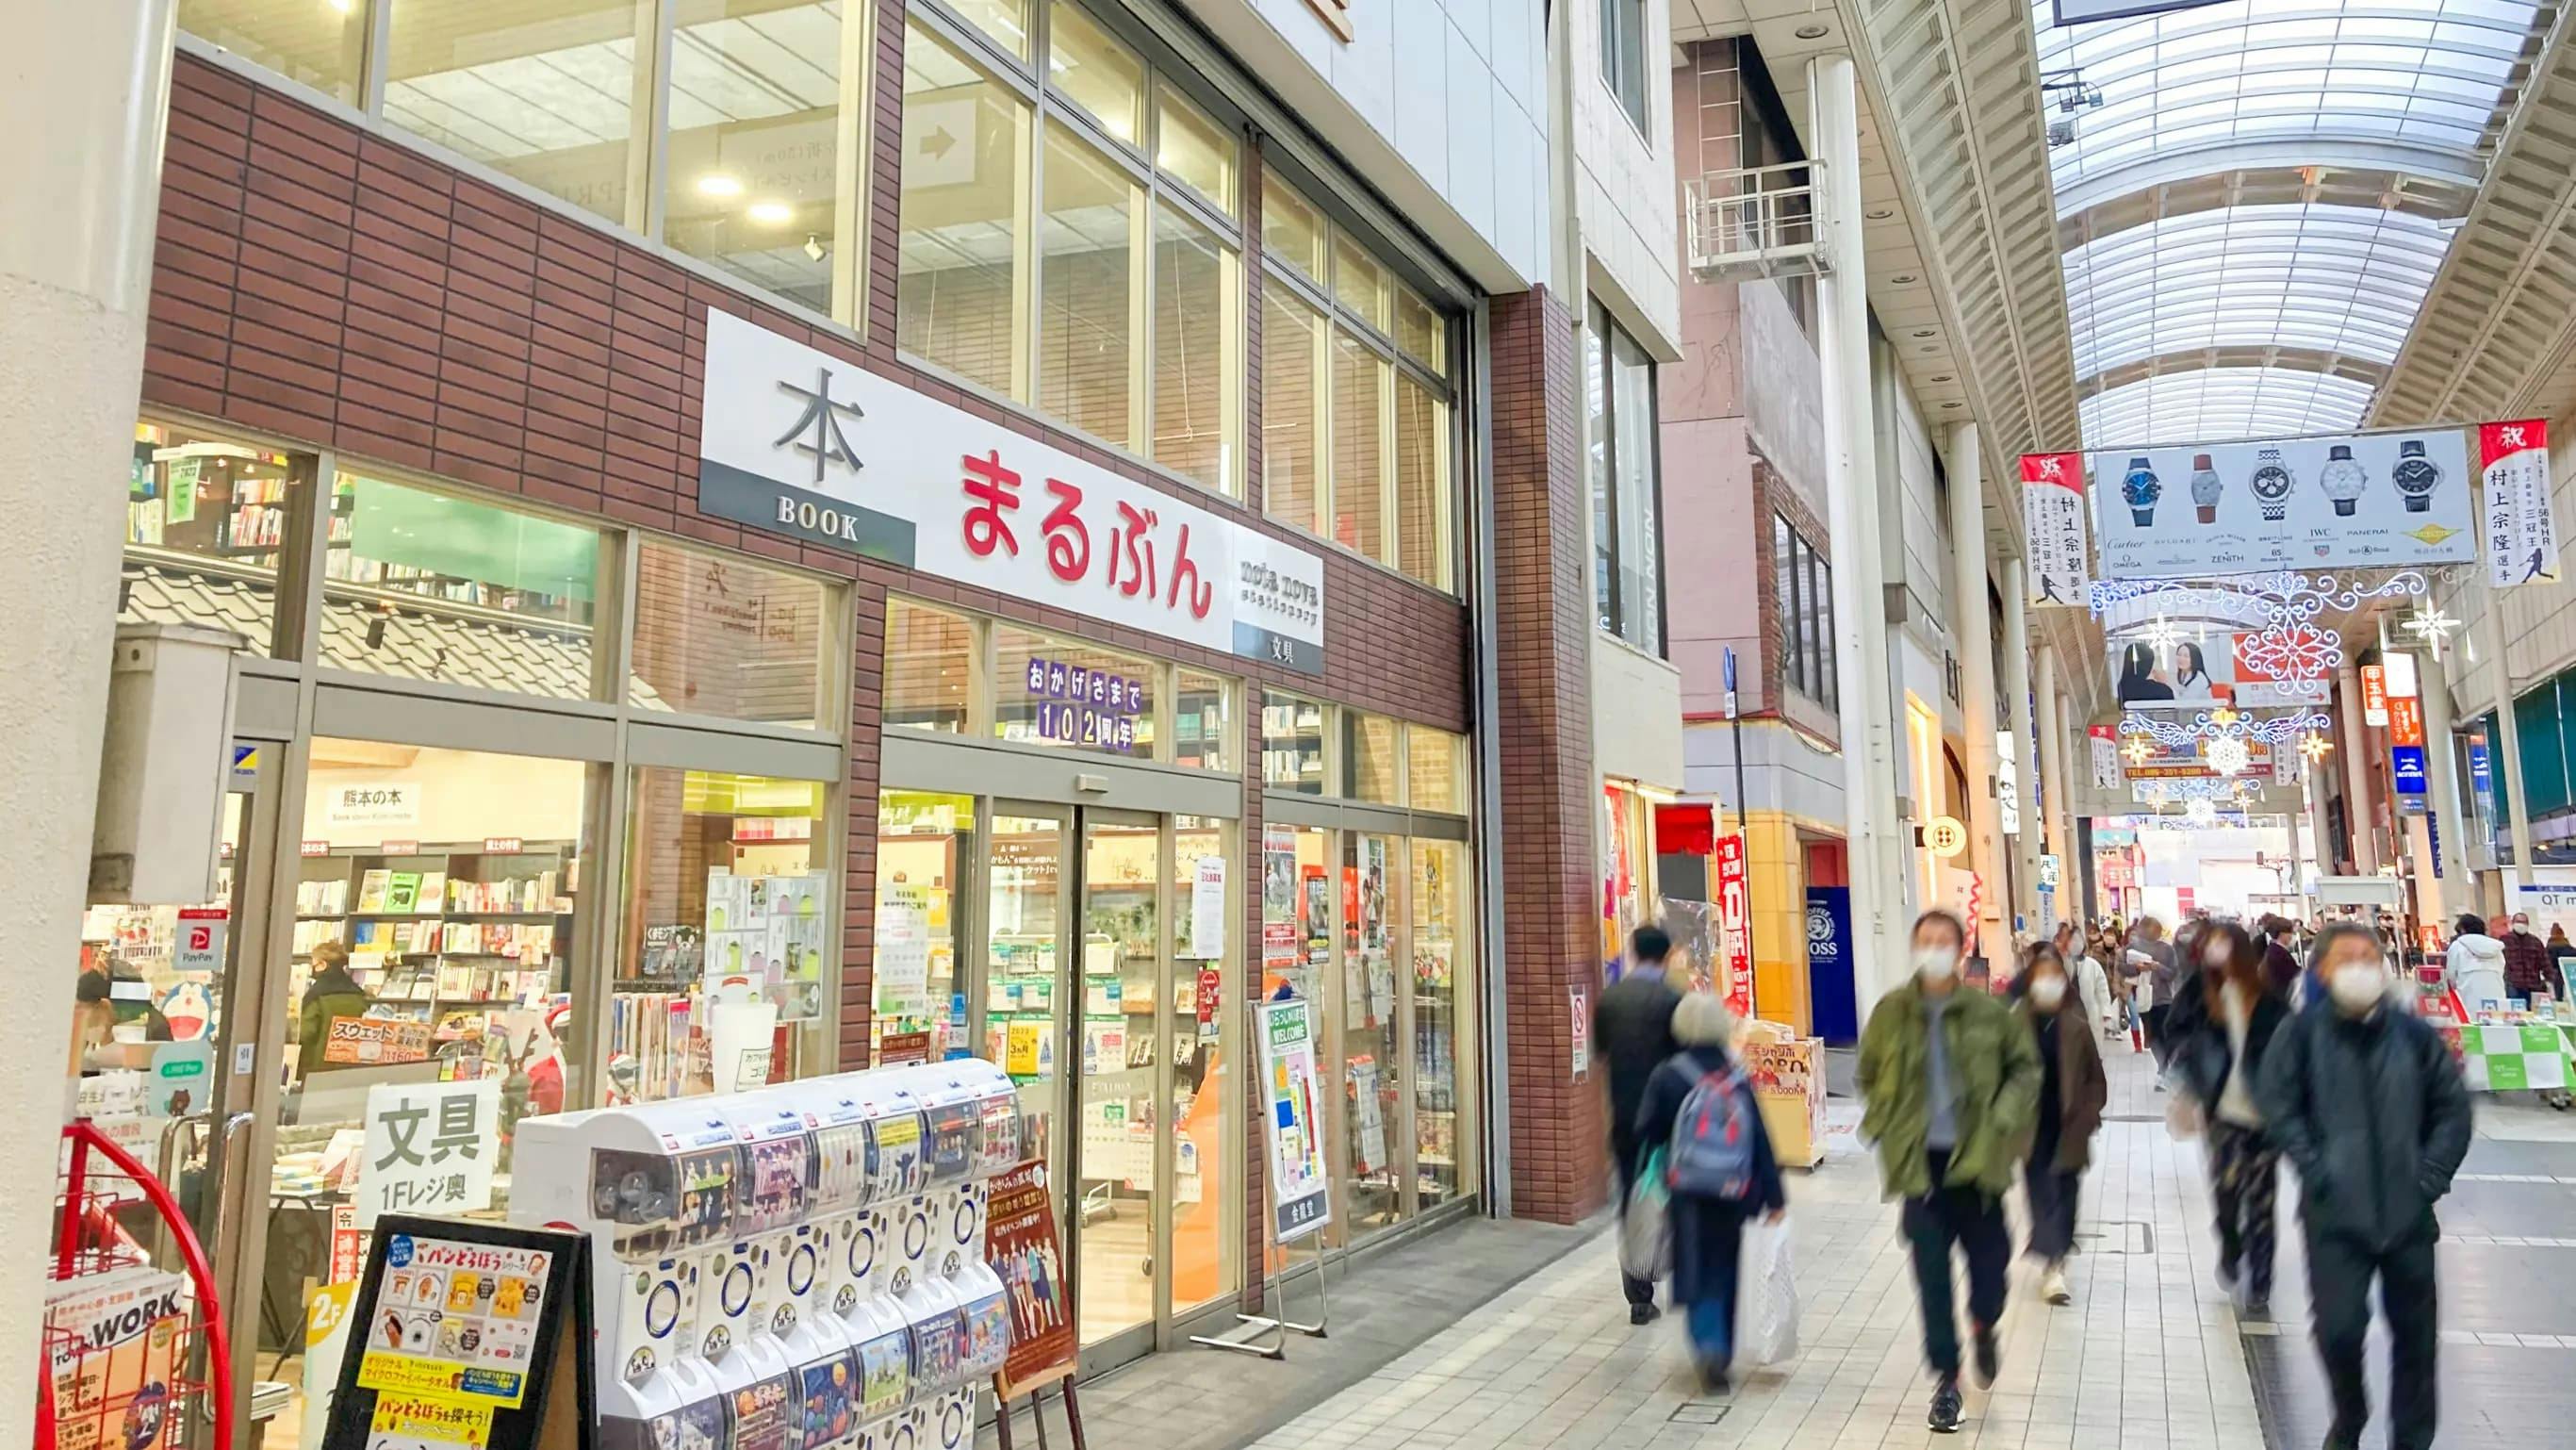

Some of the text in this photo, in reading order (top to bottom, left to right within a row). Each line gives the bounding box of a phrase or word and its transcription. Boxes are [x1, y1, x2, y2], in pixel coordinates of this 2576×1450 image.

[772, 366, 865, 483] 本
[2501, 426, 2527, 449] 祝
[777, 496, 859, 543] BOOK
[2309, 528, 2332, 537] IWC
[2346, 528, 2389, 536] PANERAI
[2489, 469, 2512, 582] 村上宗隆選手
[960, 449, 1213, 619] まるぶん
[2107, 537, 2146, 551] Cartier
[2210, 554, 2245, 564] ZENITH
[1271, 635, 1294, 664] 文具
[1029, 663, 1140, 710] おかげさまで
[343, 788, 402, 807] 熊本の本
[183, 952, 213, 963] PayPay
[1807, 942, 1838, 956] OSS
[333, 1021, 394, 1041] スウェット
[1273, 1025, 1306, 1043] WELCOME
[375, 1094, 481, 1172] 文具
[381, 1174, 467, 1211] 1Fレジ奥
[92, 1289, 182, 1349] WORK
[312, 1293, 342, 1330] 2F
